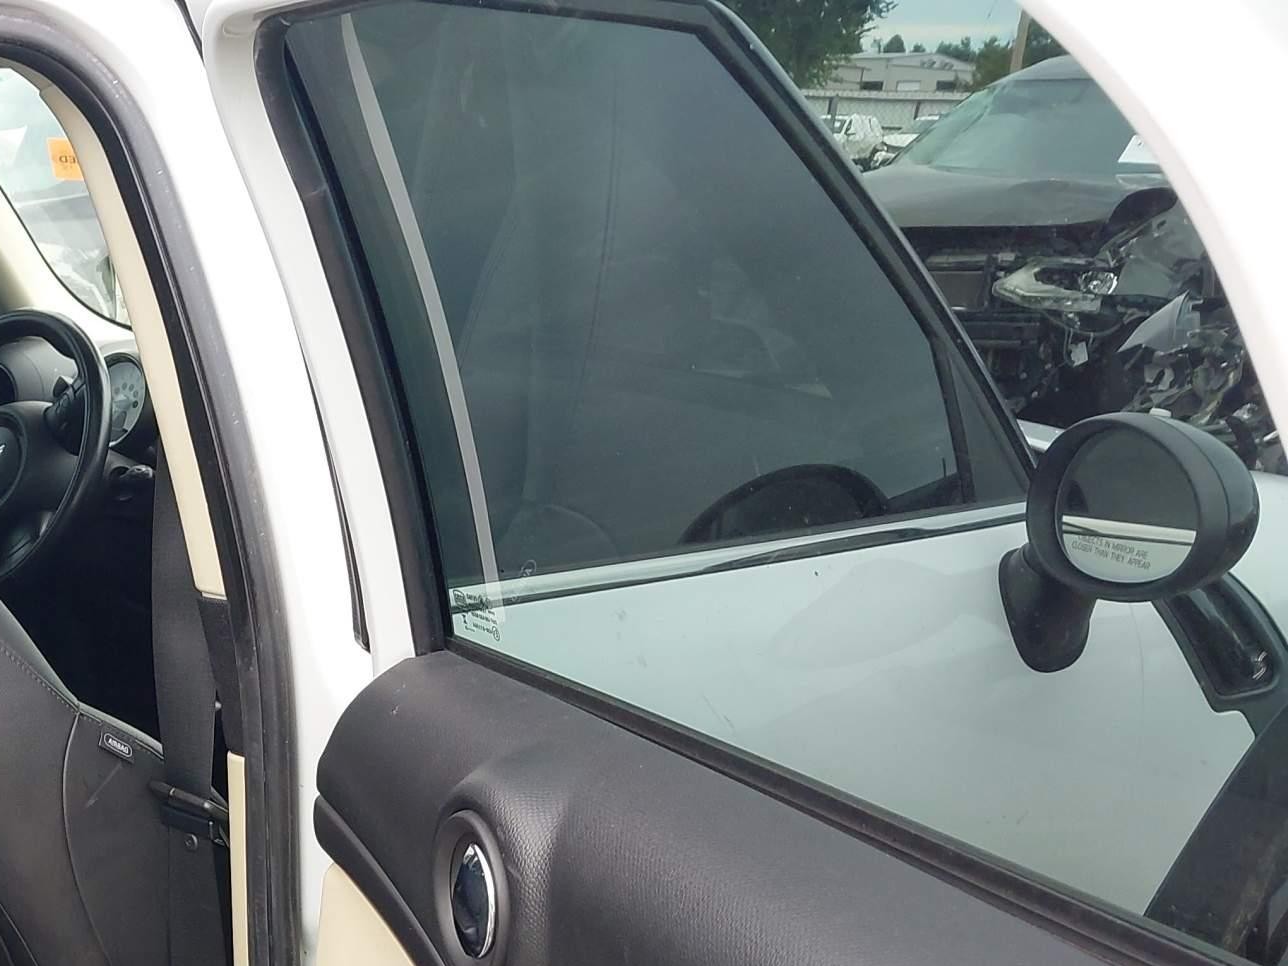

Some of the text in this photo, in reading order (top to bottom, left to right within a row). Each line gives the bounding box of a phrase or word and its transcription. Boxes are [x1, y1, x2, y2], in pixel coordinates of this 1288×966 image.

[1071, 541, 1151, 570] CLOSER THAN THEY APPEAR
[1112, 542, 1135, 555] MIRROR
[1136, 550, 1149, 559] ARE
